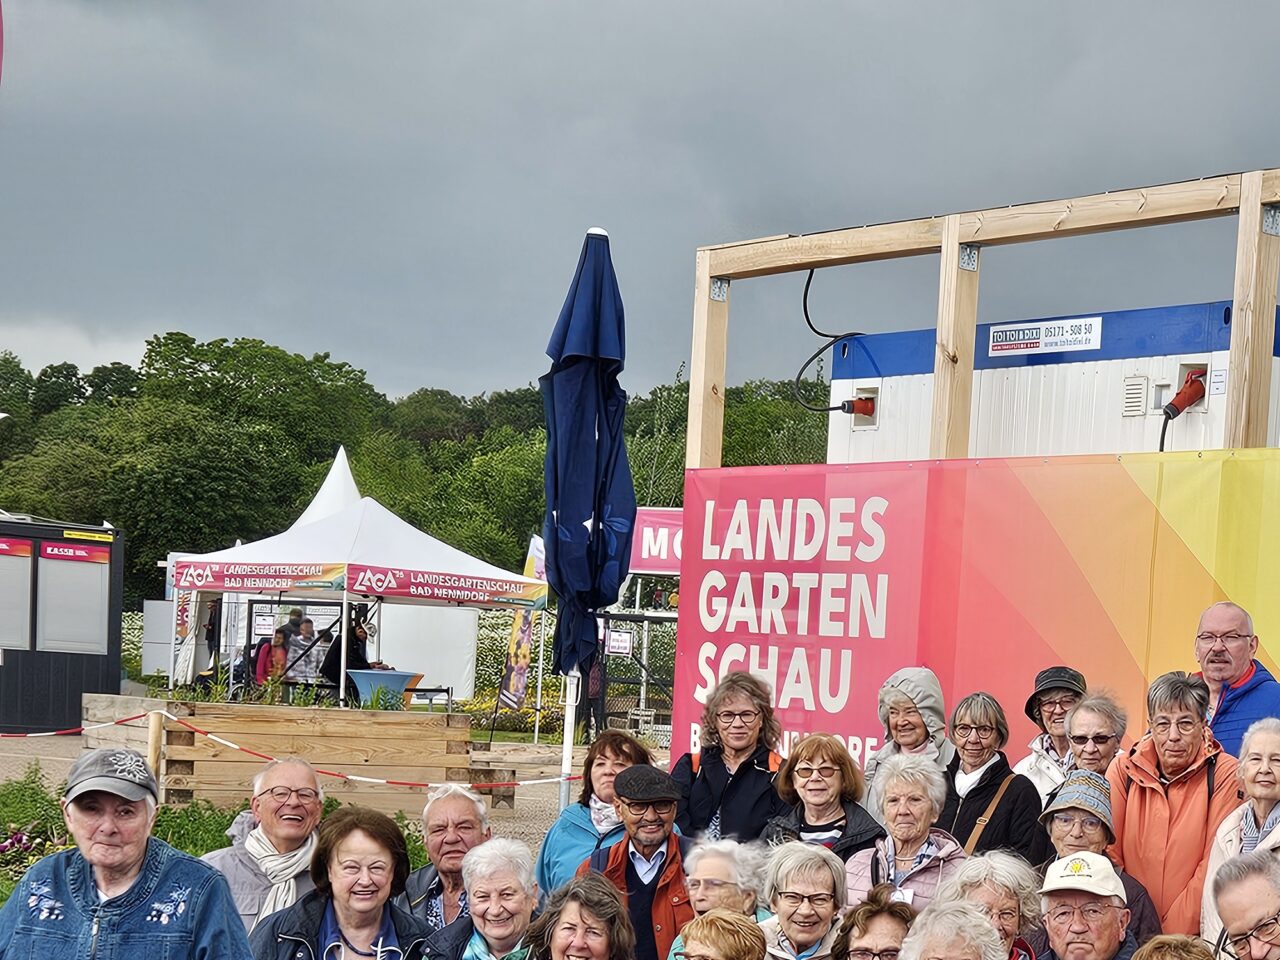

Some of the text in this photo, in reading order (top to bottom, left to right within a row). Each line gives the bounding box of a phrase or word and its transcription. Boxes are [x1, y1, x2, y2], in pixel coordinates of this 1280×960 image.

[1070, 324, 1082, 336] 508
[1084, 323, 1093, 335] 50
[701, 496, 890, 563] LANDES
[223, 565, 324, 576] LANDESGARTENSCHAU
[224, 578, 242, 588] BAD
[243, 578, 293, 588] NENNDORF
[410, 572, 524, 594] LANDESGARTENSCHAU
[410, 587, 432, 597] BAD
[434, 588, 490, 602] NENNDORF
[698, 569, 889, 639] GARTEN
